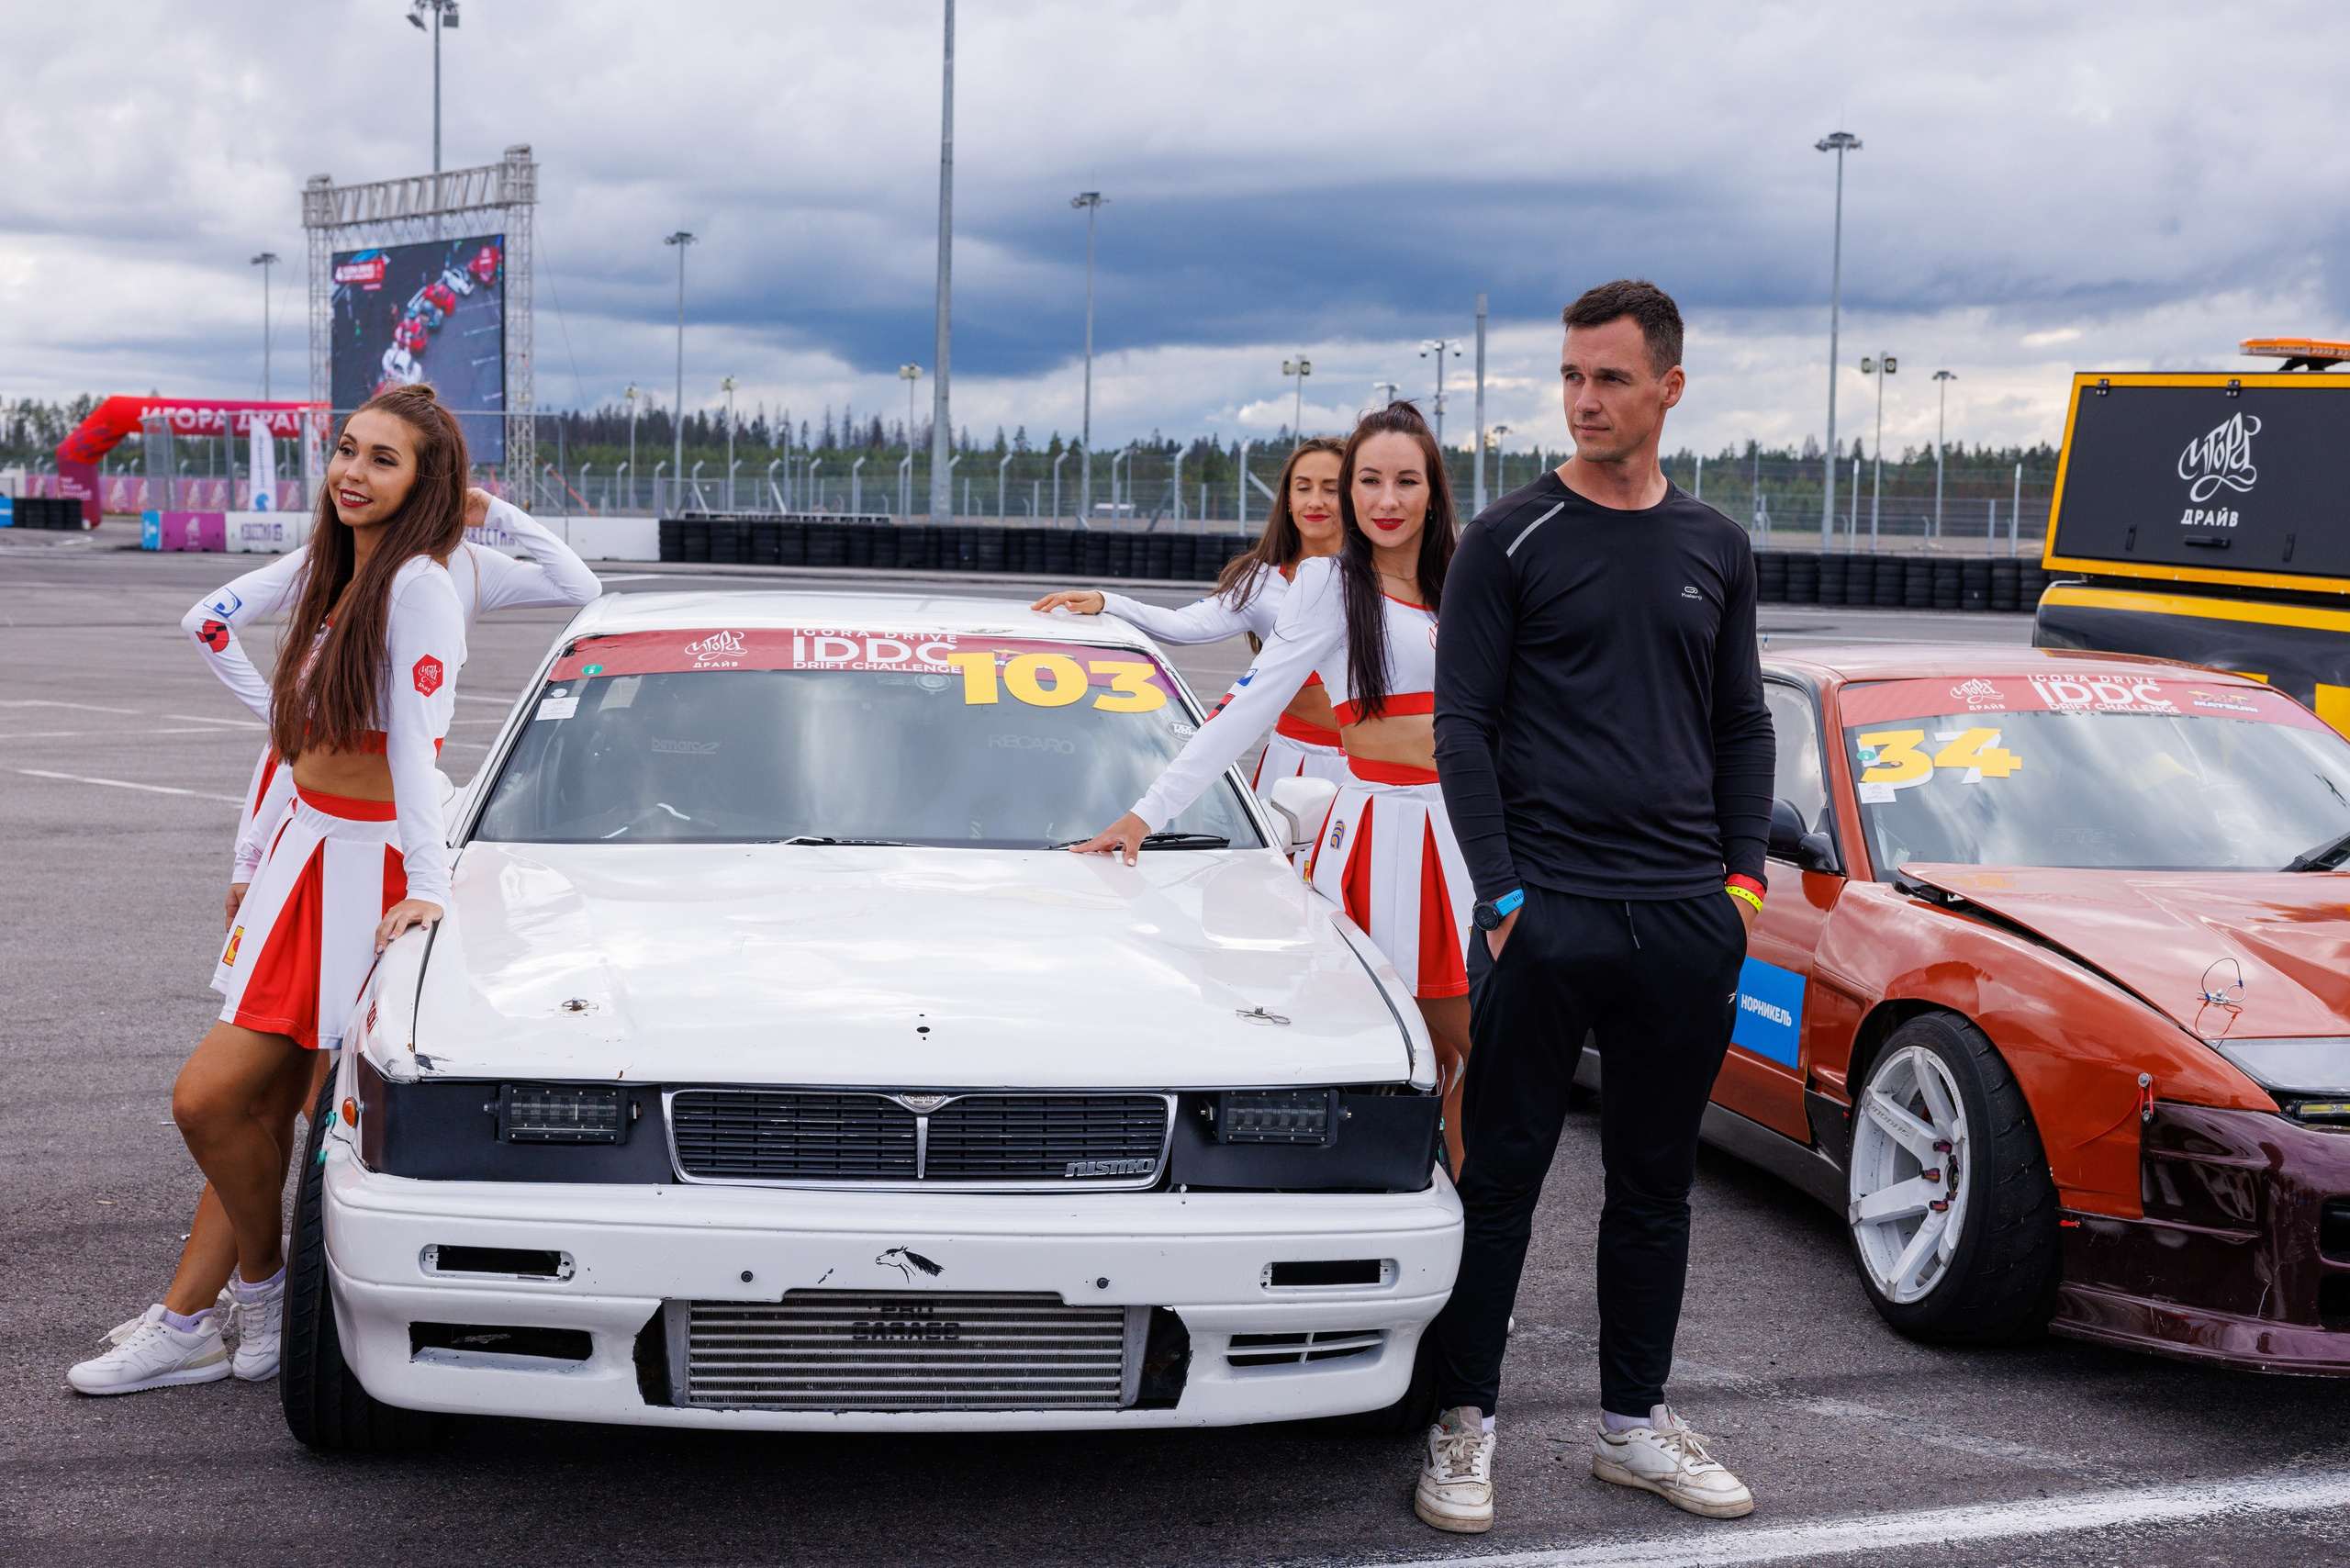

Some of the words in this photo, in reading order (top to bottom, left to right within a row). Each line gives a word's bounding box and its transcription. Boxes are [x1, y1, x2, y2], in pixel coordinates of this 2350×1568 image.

[2180, 507, 2239, 527] ДРАЙВ
[793, 628, 870, 637] IGORA
[884, 632, 958, 644] DRIVE
[793, 636, 958, 665] IDDC
[793, 661, 846, 670] DRIFT
[858, 661, 962, 674] CHALLENGE
[946, 652, 1168, 713] 103
[2027, 674, 2090, 683] IGORA
[2098, 675, 2157, 686] DRIVE
[2031, 681, 2174, 706] IDDC
[1968, 703, 2006, 711] ДРАЙВ
[2047, 702, 2092, 711] DRIFT
[2094, 703, 2182, 713] CHALLENGE
[987, 734, 1076, 755] RECARO
[1860, 727, 2022, 783] 34
[1740, 993, 1792, 1027] НОРНИКЕЛЬ
